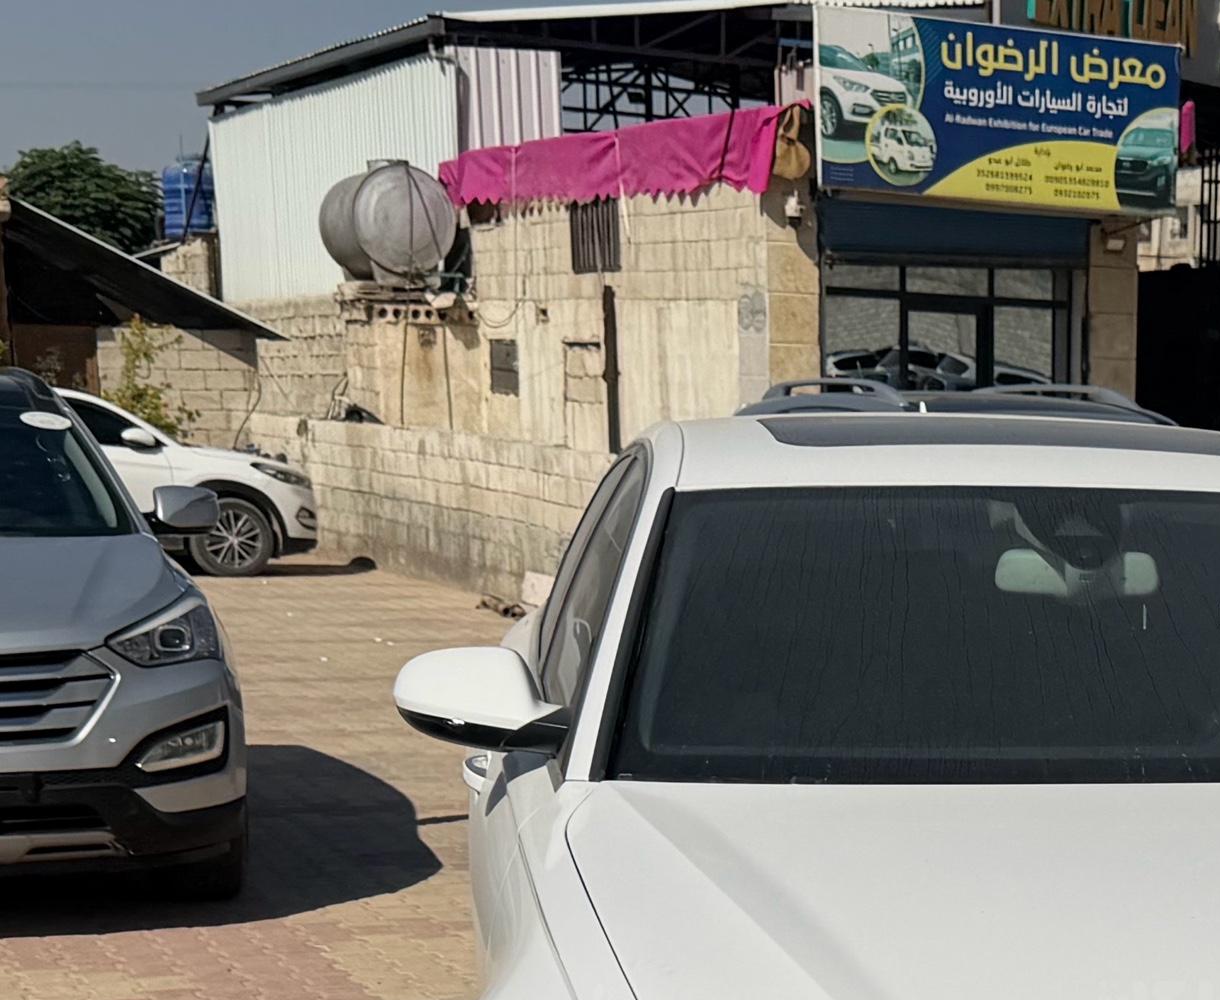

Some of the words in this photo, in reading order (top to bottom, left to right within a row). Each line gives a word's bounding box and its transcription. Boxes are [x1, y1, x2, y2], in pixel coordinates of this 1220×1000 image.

[940, 31, 1059, 81] الرضوان
[1070, 48, 1167, 90] معرض
[943, 80, 1013, 108] الأوروبية
[1017, 88, 1082, 114] السيارات
[1086, 95, 1129, 119] لتجارة
